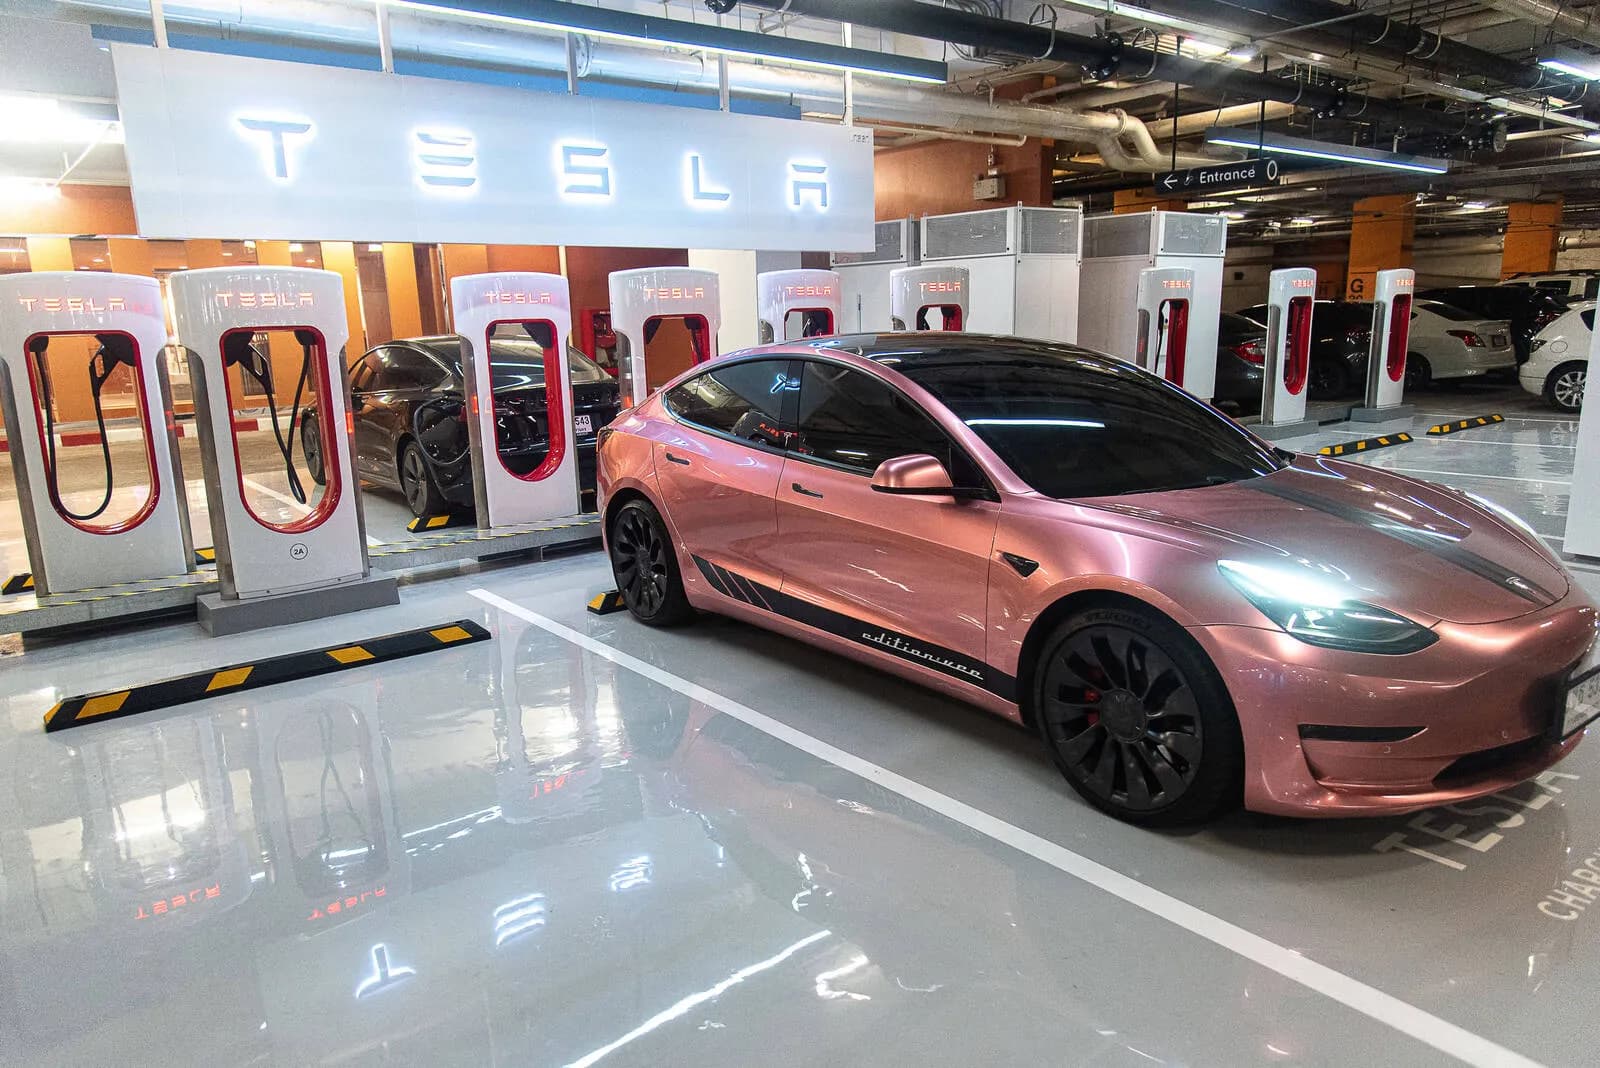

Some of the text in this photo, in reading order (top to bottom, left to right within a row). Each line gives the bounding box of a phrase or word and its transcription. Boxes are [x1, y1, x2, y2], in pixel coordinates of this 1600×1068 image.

[236, 114, 829, 206] TESLA
[785, 285, 832, 297] TESLA
[918, 281, 961, 293] TESLA
[1162, 280, 1192, 289] TESLA
[1350, 278, 1364, 293] G
[215, 290, 315, 308] TESLA
[485, 291, 551, 305] TESLA
[644, 286, 704, 300] TESLA
[17, 295, 127, 313] TESLA
